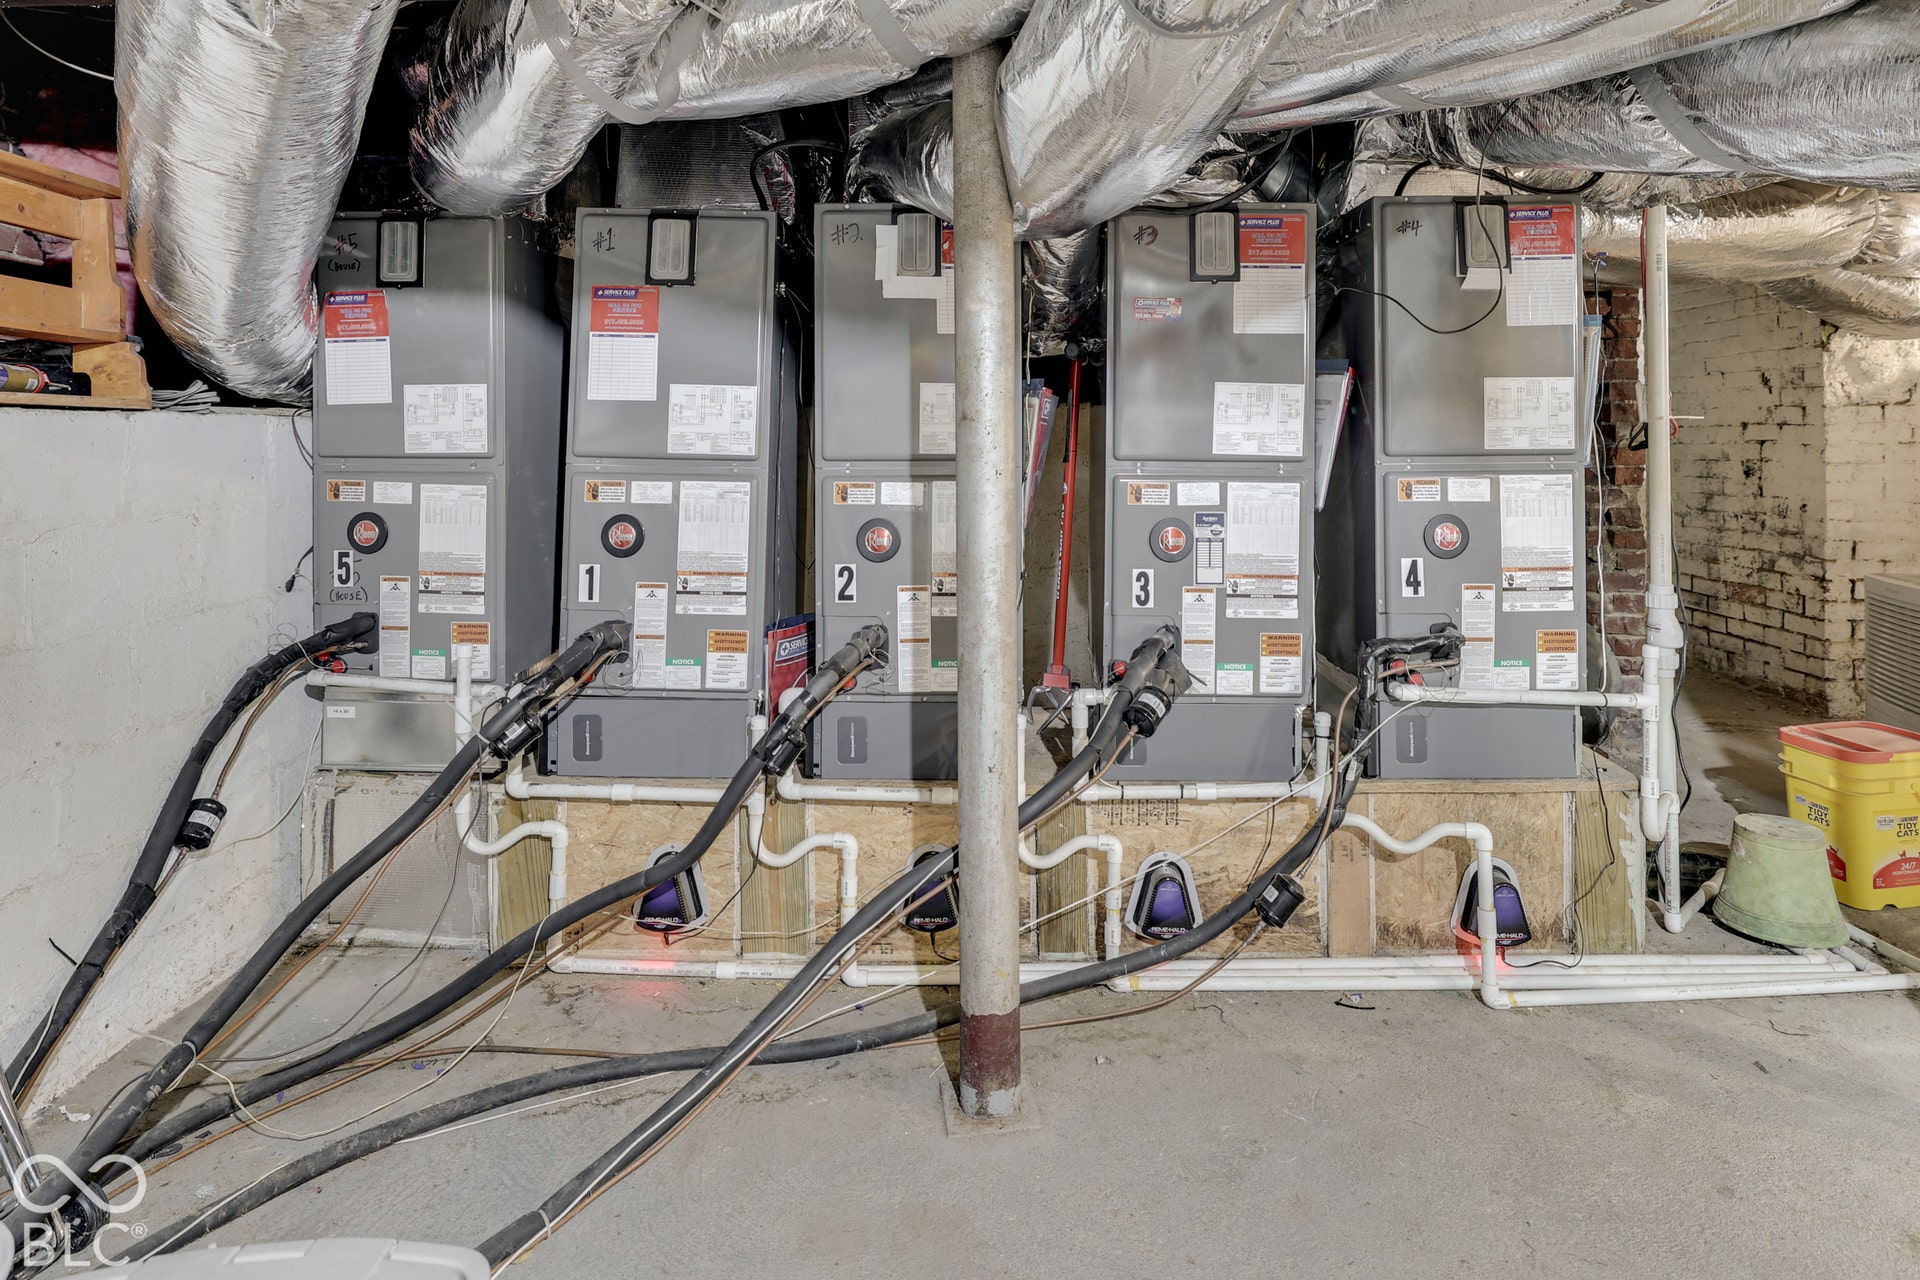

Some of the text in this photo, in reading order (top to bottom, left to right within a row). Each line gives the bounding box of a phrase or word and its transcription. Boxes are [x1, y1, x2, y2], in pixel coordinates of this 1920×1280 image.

[830, 222, 863, 245] #2
[1133, 225, 1158, 246] #3
[1396, 220, 1423, 236] #4
[333, 233, 358, 255] #5
[338, 552, 350, 585] 5
[1405, 559, 1421, 596] 4
[585, 565, 595, 600] 1
[838, 565, 854, 601] 2
[1135, 571, 1150, 606] 3
[330, 586, 368, 603] (HOUSE)
[1807, 813, 1830, 827] CATS
[1808, 806, 1828, 817] TIDY
[1896, 829, 1919, 838] CATS
[1897, 822, 1918, 830] TIDY
[1901, 861, 1916, 871] 24/7
